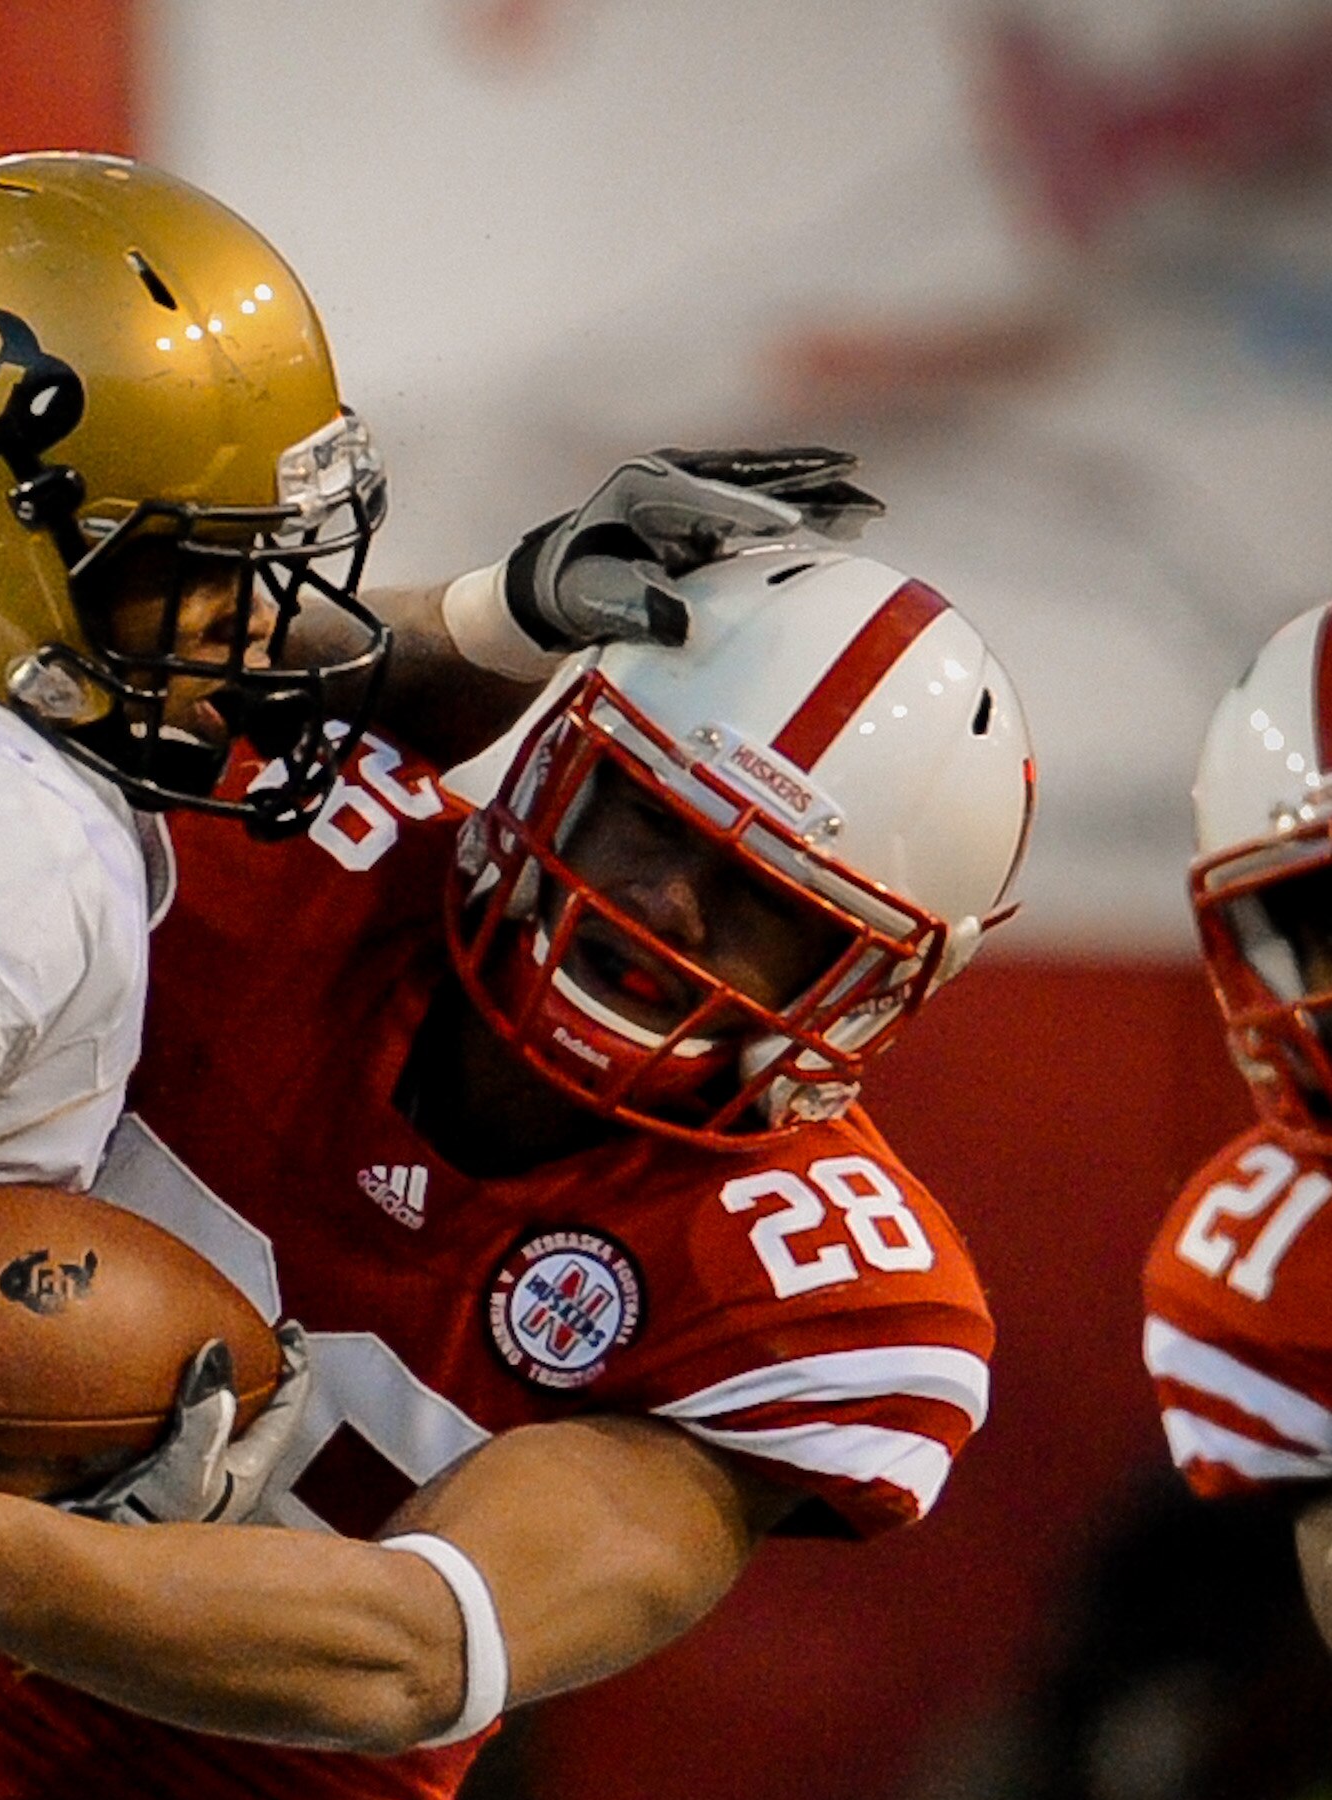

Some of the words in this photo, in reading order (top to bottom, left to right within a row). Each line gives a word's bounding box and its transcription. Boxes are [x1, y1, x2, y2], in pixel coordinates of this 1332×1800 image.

[731, 745, 812, 814] HUSKERS
[357, 1168, 425, 1230] adidas
[719, 1155, 935, 1300] 28
[1175, 1143, 1332, 1302] 21
[520, 1231, 614, 1261] NEBRASKA
[611, 1258, 640, 1345] FOOTBALL
[525, 1273, 607, 1348] HUSKERS
